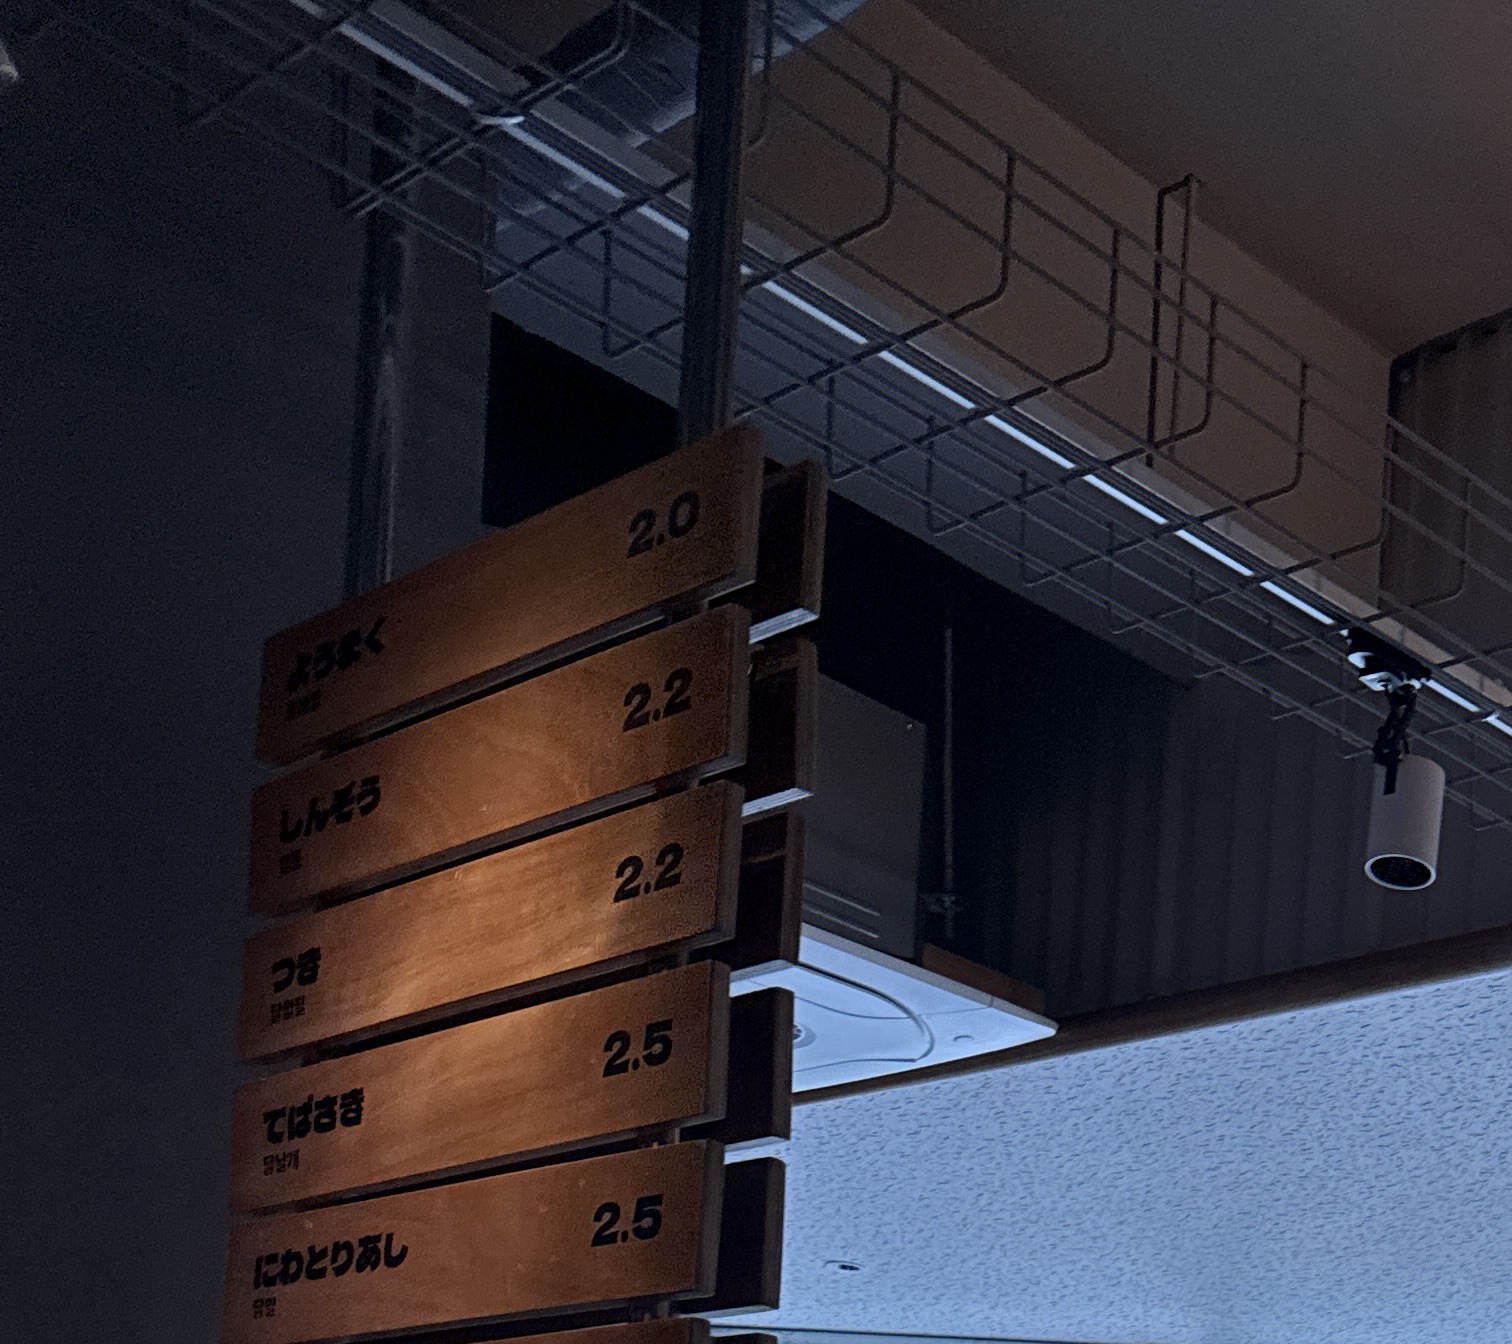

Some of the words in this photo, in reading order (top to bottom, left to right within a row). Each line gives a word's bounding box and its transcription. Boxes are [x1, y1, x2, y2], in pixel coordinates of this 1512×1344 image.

[626, 491, 700, 559] 2.0
[622, 667, 693, 732] 2.2
[613, 843, 684, 903] 2.2
[603, 1019, 674, 1077] 2.5
[591, 1194, 664, 1247] 2.5
[254, 1232, 408, 1289] にわとりあし
